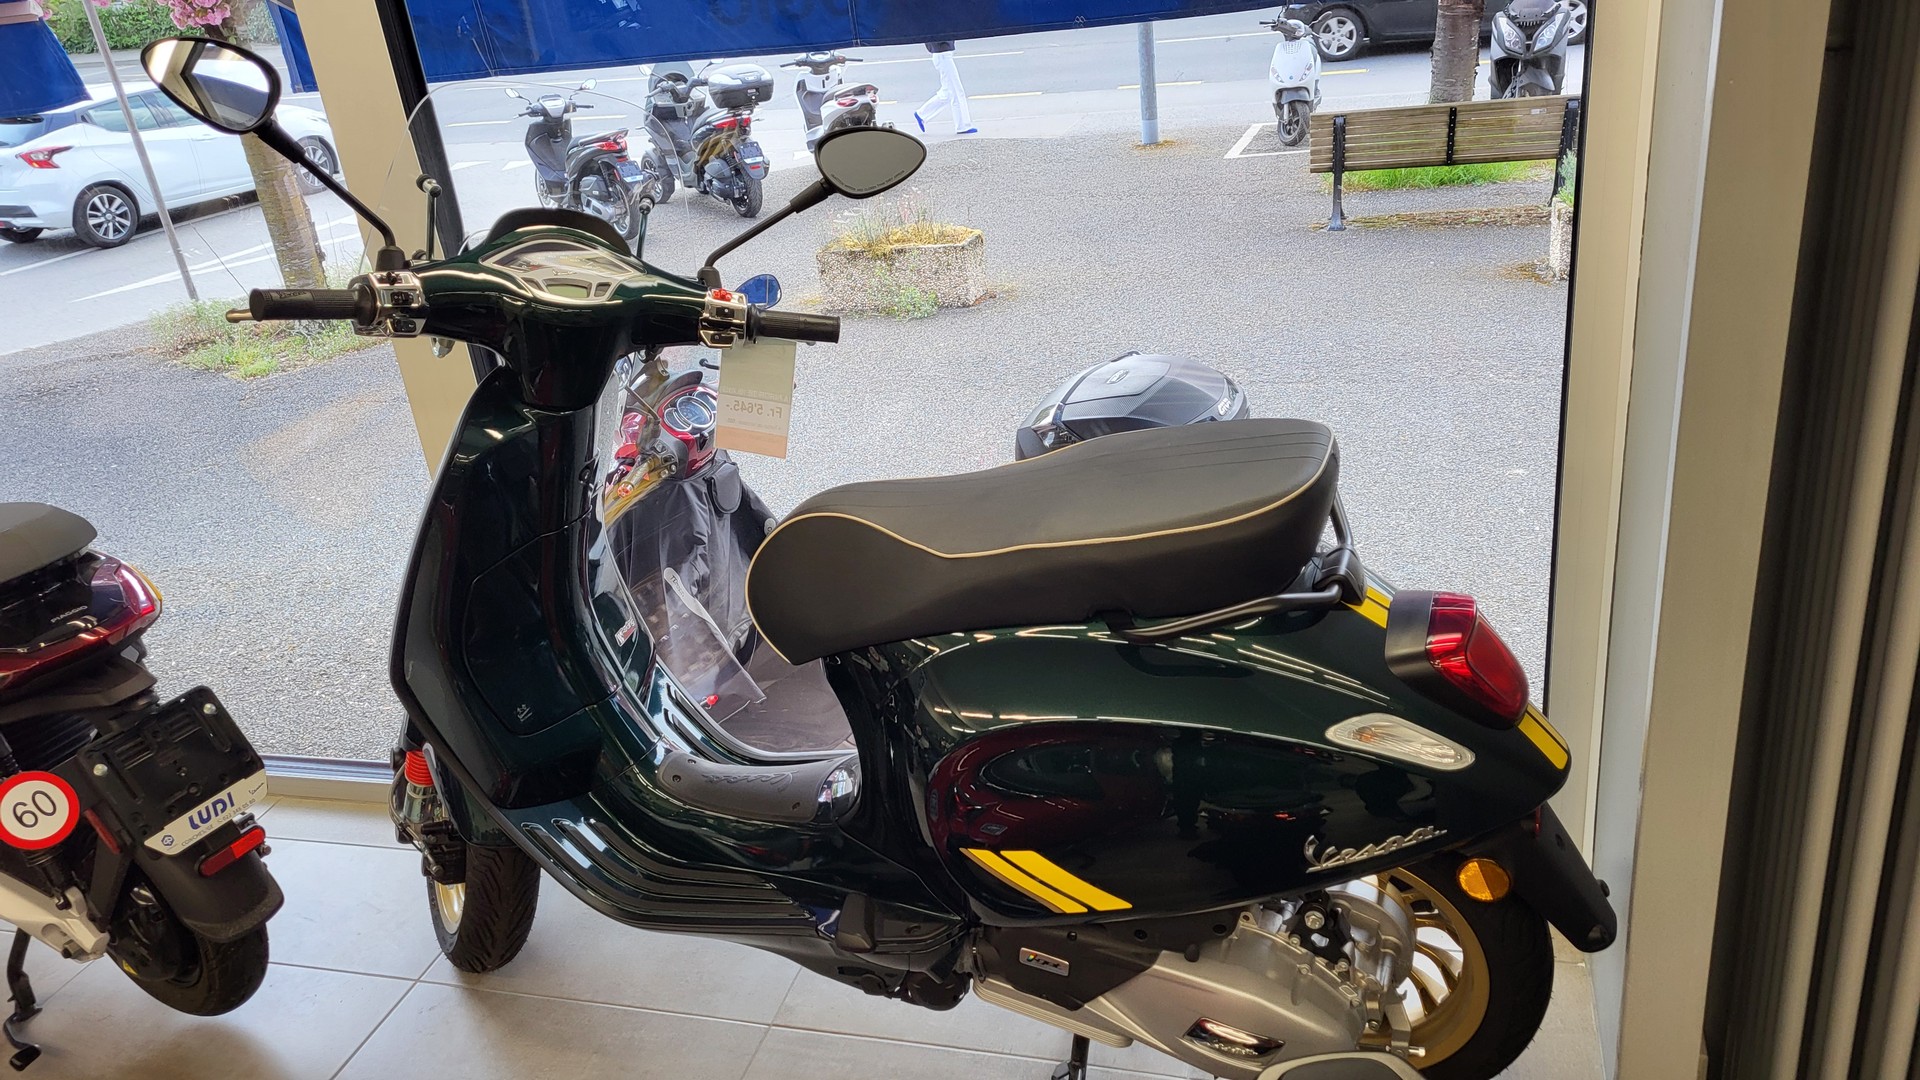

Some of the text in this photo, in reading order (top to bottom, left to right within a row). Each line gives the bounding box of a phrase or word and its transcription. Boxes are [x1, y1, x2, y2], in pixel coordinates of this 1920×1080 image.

[50, 605, 88, 623] PIAGGIO
[12, 789, 57, 828] 60
[188, 791, 235, 830] LUDI
[1305, 825, 1449, 873] Vespa
